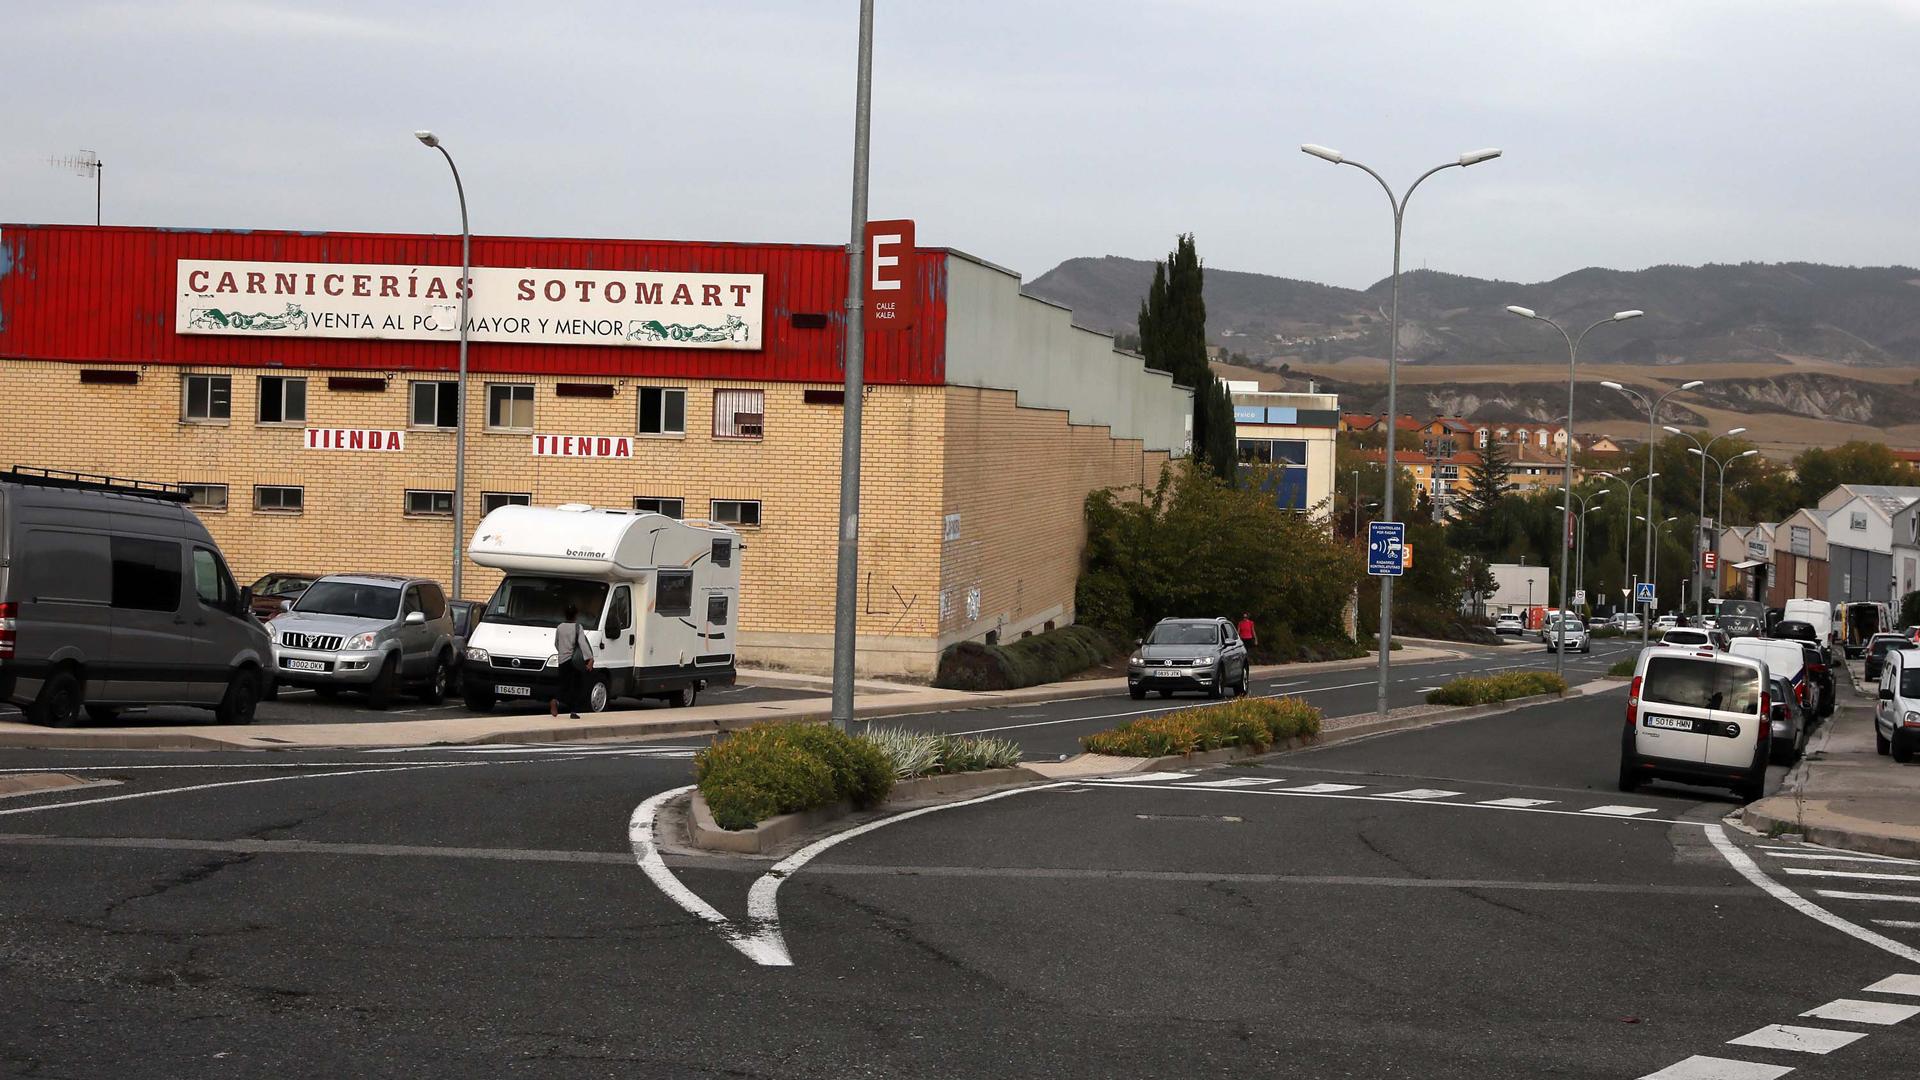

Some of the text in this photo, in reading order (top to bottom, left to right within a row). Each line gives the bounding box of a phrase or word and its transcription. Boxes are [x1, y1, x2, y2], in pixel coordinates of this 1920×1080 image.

[872, 234, 901, 290] E
[188, 268, 751, 307] CARNICERÍAS SOTOMART
[876, 302, 896, 310] CALLE
[875, 311, 896, 319] KALEA
[310, 312, 375, 329] VENTA
[382, 315, 405, 330] AL
[413, 315, 438, 331] PO
[538, 319, 549, 334] Y
[555, 320, 623, 336] MENOR
[308, 429, 401, 450] TIENDA
[536, 436, 630, 457] TIENDA
[566, 548, 606, 558] benimar
[1705, 553, 1715, 564] E
[1655, 718, 1691, 728] 5016 HMN
